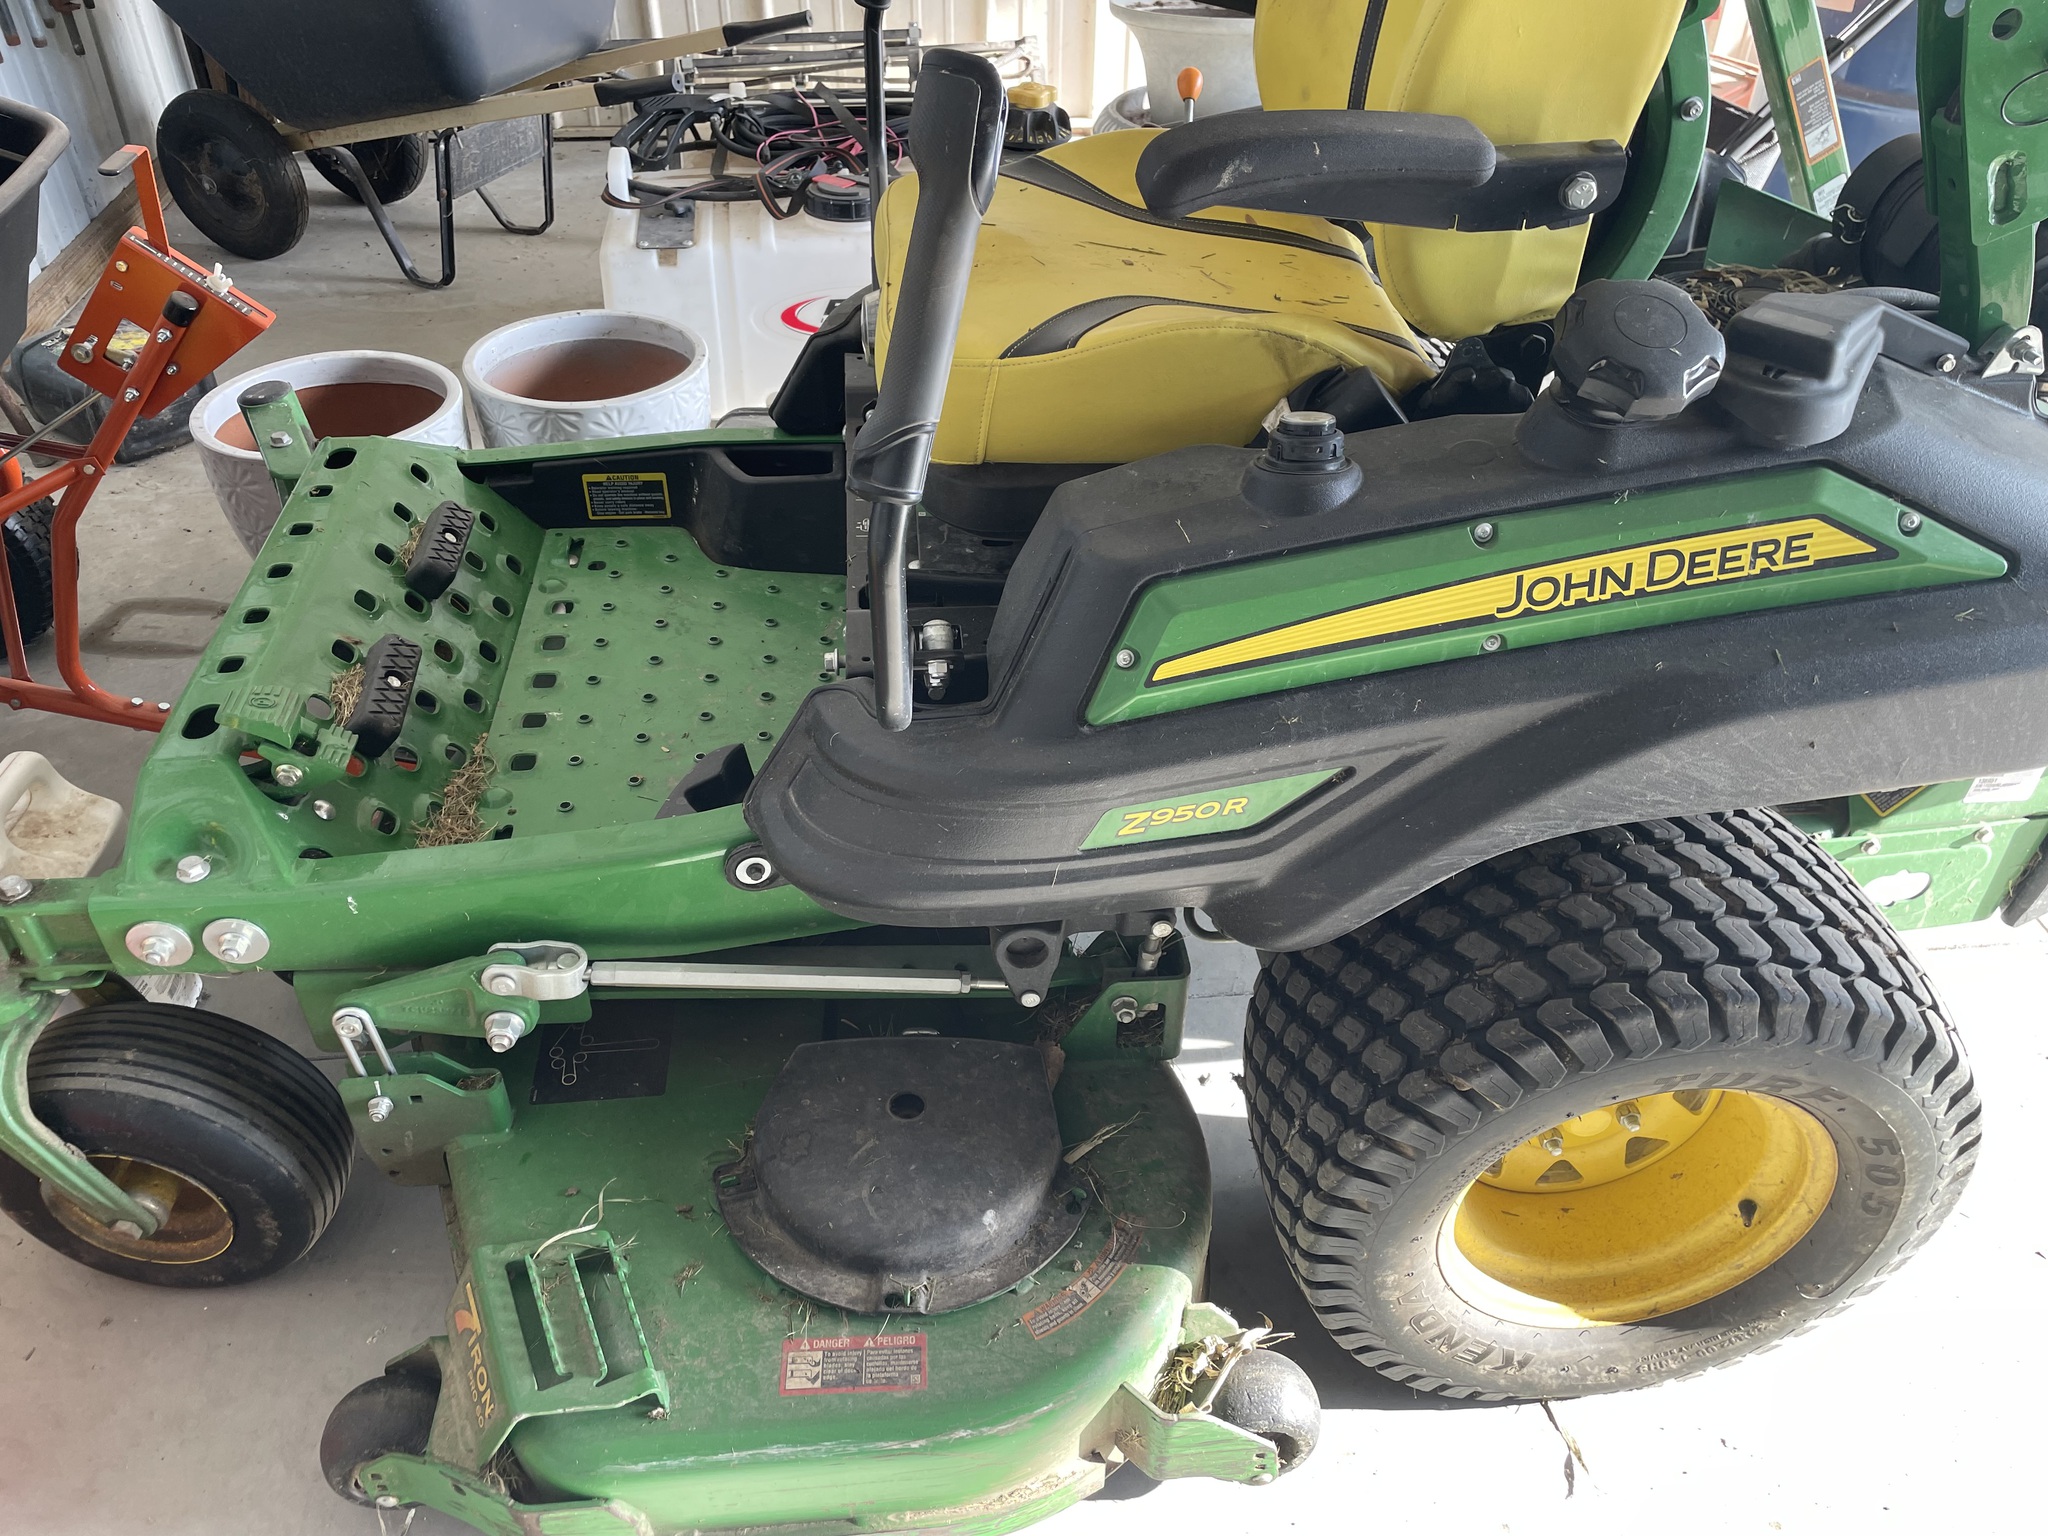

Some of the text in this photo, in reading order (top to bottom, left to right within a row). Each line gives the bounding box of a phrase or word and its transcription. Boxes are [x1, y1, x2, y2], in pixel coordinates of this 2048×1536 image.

[1495, 532, 1814, 616] JOHN DEERE
[1653, 1072, 1847, 1103] TURF
[1857, 1136, 1901, 1217] 505
[813, 1339, 850, 1348] DANGER
[877, 1336, 916, 1346] PELIGRO
[1397, 1281, 1536, 1375] KENDA
[467, 1370, 478, 1402] PRO
